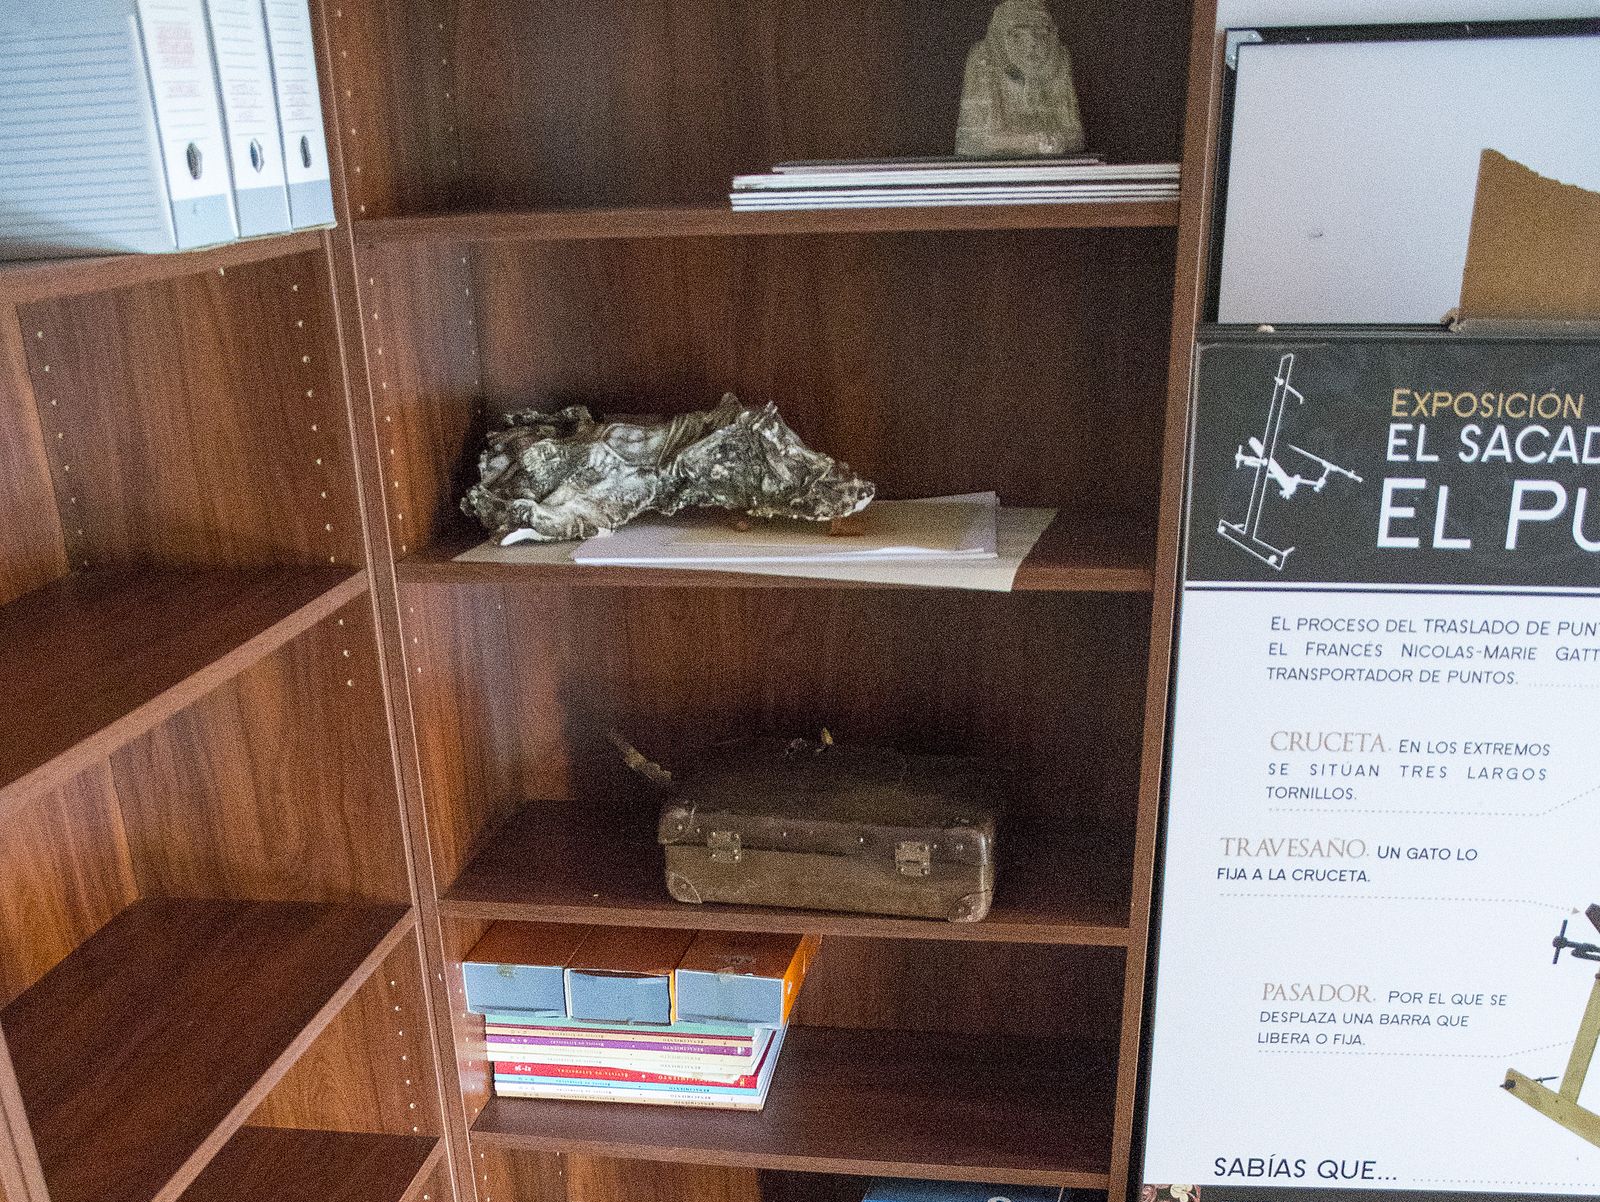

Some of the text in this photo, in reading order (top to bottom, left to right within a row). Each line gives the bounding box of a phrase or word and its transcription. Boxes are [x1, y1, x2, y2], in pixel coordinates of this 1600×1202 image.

[1391, 387, 1585, 419] EXPOSICIÓN
[1386, 422, 1440, 462] EL
[1377, 478, 1472, 549] EL
[1271, 616, 1600, 637] EL PROCESO DEL TRASLADO DE PUN
[1268, 642, 1287, 656] EL
[1401, 643, 1537, 660] NICOLAS-MARIE
[1267, 667, 1519, 685] TRANSPORTADOR DE PUNTOS.
[1270, 731, 1550, 756] CRUCETA. EN LOS EXTREMOS
[1268, 763, 1289, 775] SE
[1400, 765, 1447, 779] TRES
[1467, 766, 1547, 781] LARGOS
[1266, 786, 1357, 800] TORNILLOS.
[1220, 836, 1478, 861] TRAVESAÑO. UN GATO LO
[1217, 867, 1371, 882] FIJA A LA CRUCETA.
[1263, 982, 1507, 1006] PASADOR. POR EL QUE SE
[1260, 1011, 1469, 1027] DESPLAZA UNA BARRA QUE
[1257, 1032, 1366, 1045] LIBERA O FIJA.
[1214, 1154, 1397, 1180] SABÍAS QUE...
